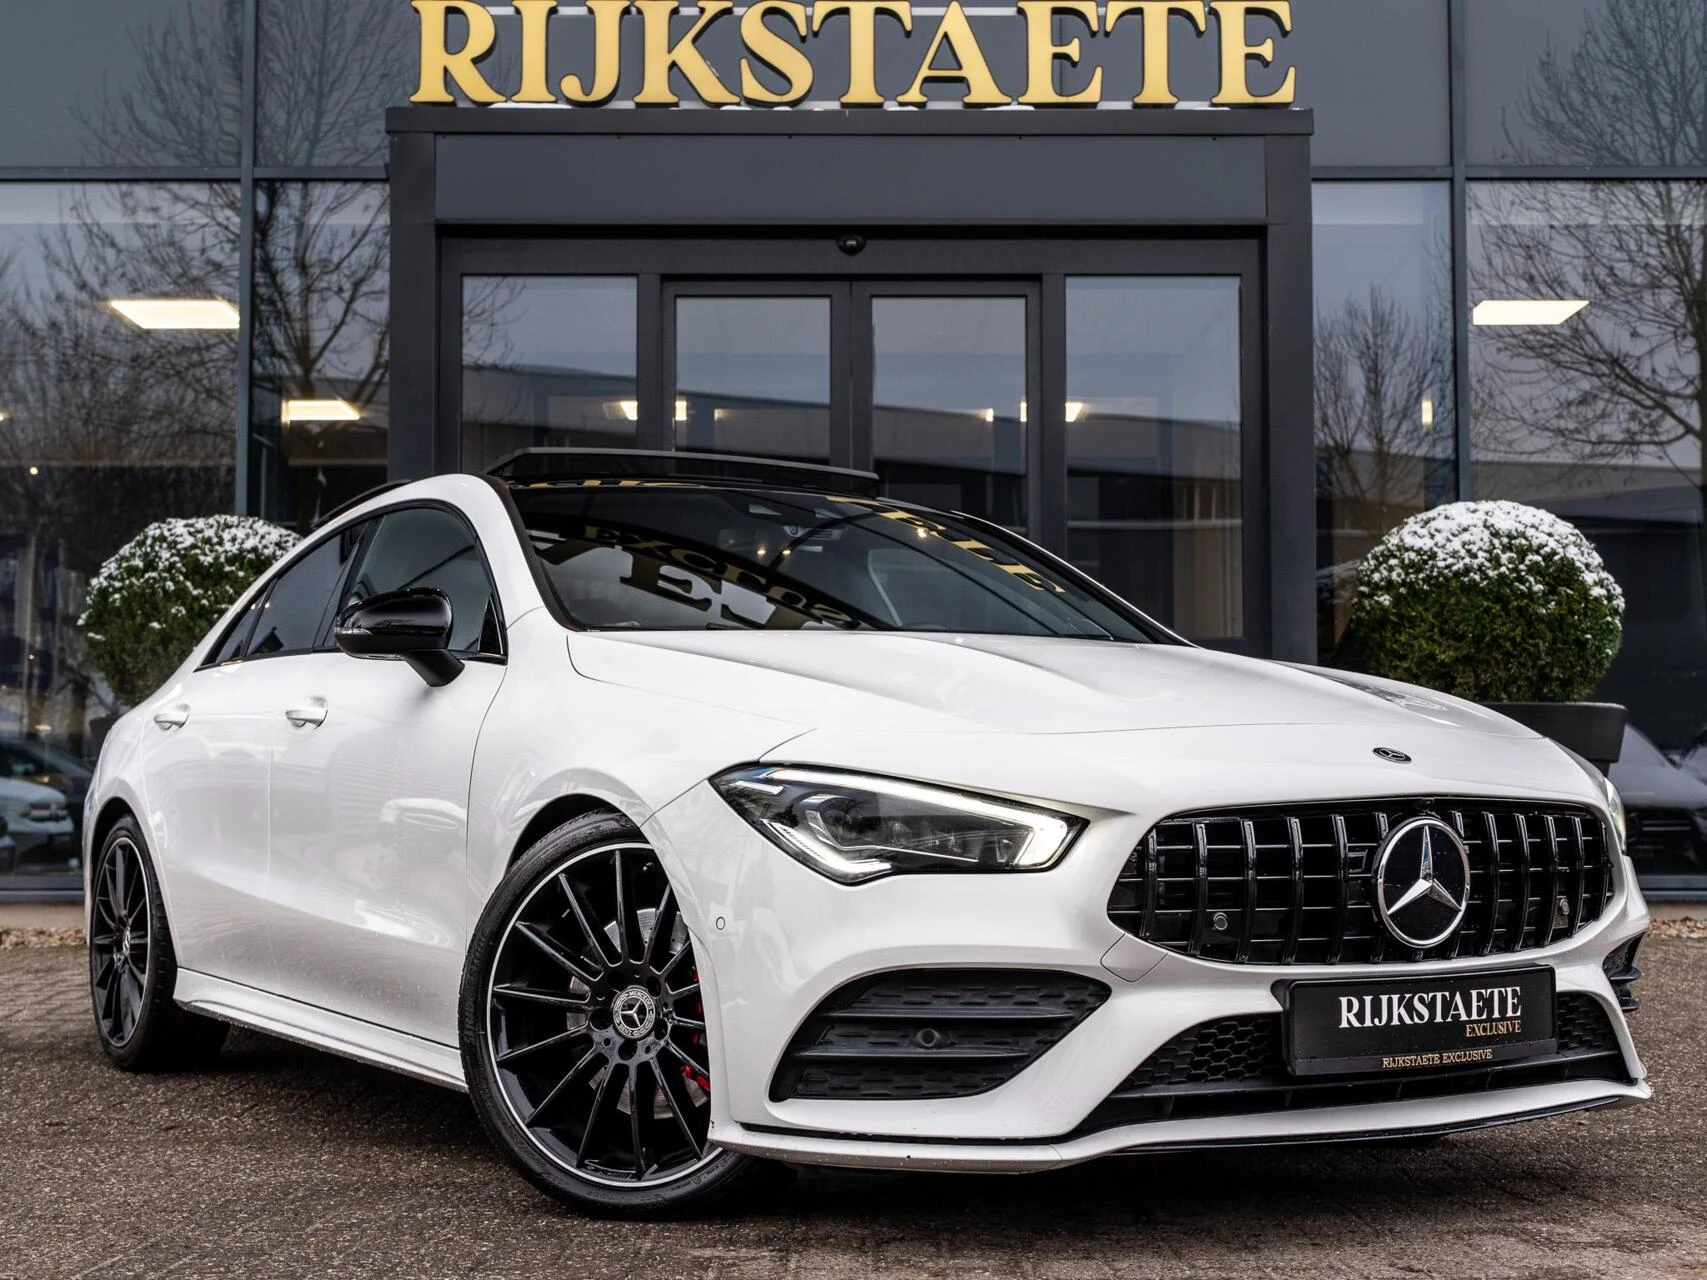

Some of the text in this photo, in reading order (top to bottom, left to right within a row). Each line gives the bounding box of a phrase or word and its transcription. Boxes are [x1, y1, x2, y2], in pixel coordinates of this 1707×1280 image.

[411, 0, 1297, 105] RIJKSTAETE
[1338, 986, 1522, 1028] RIJKSTAETE
[1465, 1020, 1522, 1038] EXCLUSIVE
[1382, 1049, 1493, 1069] RIJKSTAETE EXCLUSIVE
